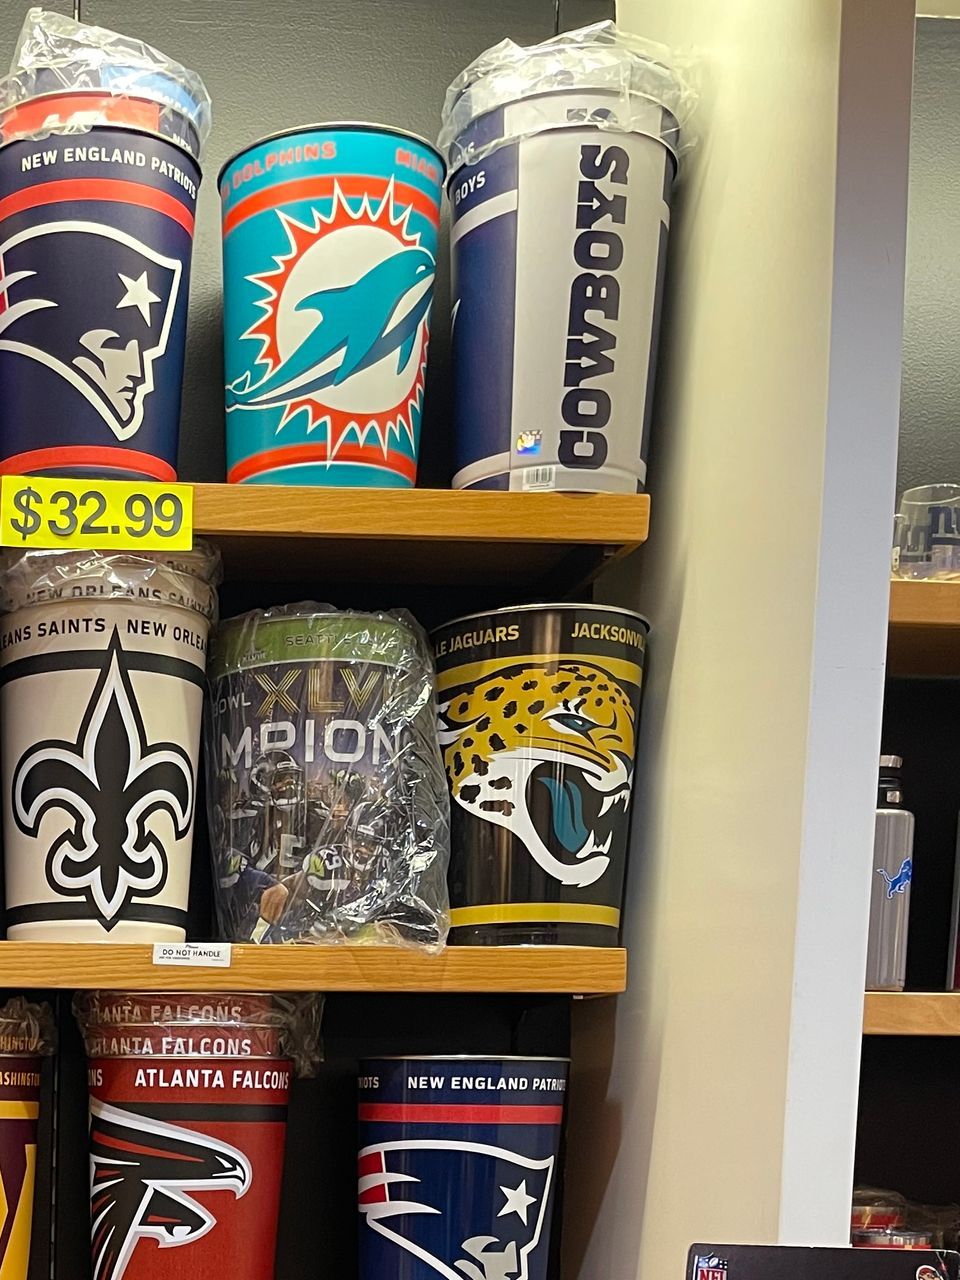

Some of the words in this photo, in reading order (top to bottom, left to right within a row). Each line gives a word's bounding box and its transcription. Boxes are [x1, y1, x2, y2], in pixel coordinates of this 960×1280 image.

[21, 151, 57, 172] NEW
[64, 147, 146, 167] ENGLAND
[151, 156, 196, 200] PATRIOTS
[233, 141, 336, 188] DOLPHINS
[558, 145, 630, 470] COWBOYS
[11, 487, 183, 541] $32.99
[37, 617, 106, 638] SAINTS
[127, 619, 166, 637] NEW
[448, 625, 520, 652] JAGUARS
[135, 1069, 224, 1088] ATLANTA
[233, 1071, 289, 1090] FALCONS
[408, 1077, 444, 1089] NEW
[451, 1078, 528, 1091] ENGLAND
